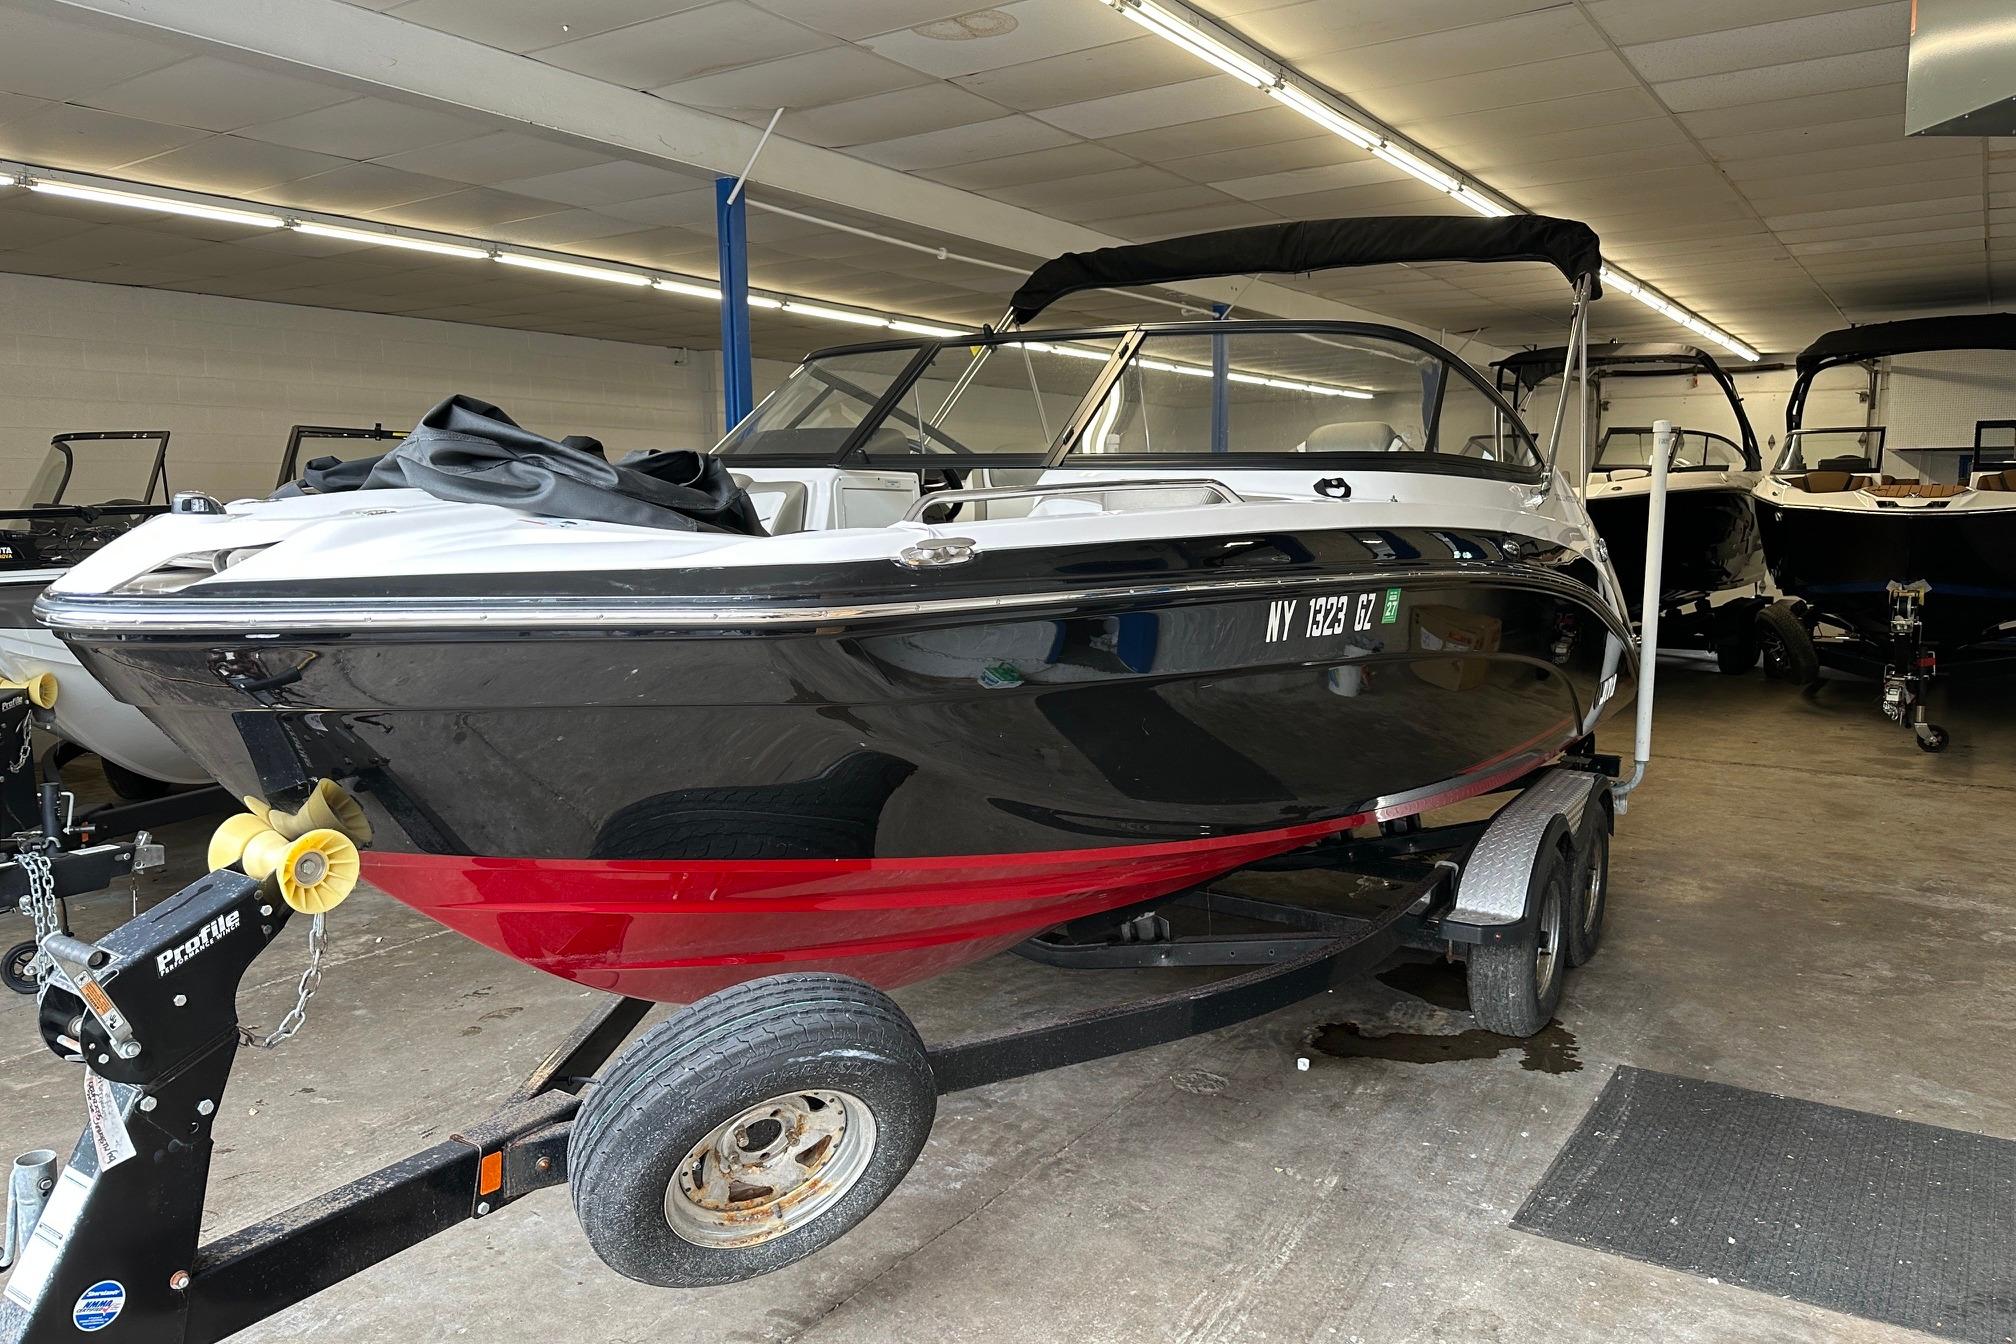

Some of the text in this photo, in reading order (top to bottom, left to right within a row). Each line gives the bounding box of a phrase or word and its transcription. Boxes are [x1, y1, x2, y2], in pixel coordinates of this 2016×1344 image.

[1265, 593, 1377, 643] NY 1323 GZ
[1385, 601, 1398, 616] 27
[157, 910, 240, 973] Profile
[159, 921, 240, 977] PERFORMANCE WINCH
[83, 1299, 113, 1309] NMMA
